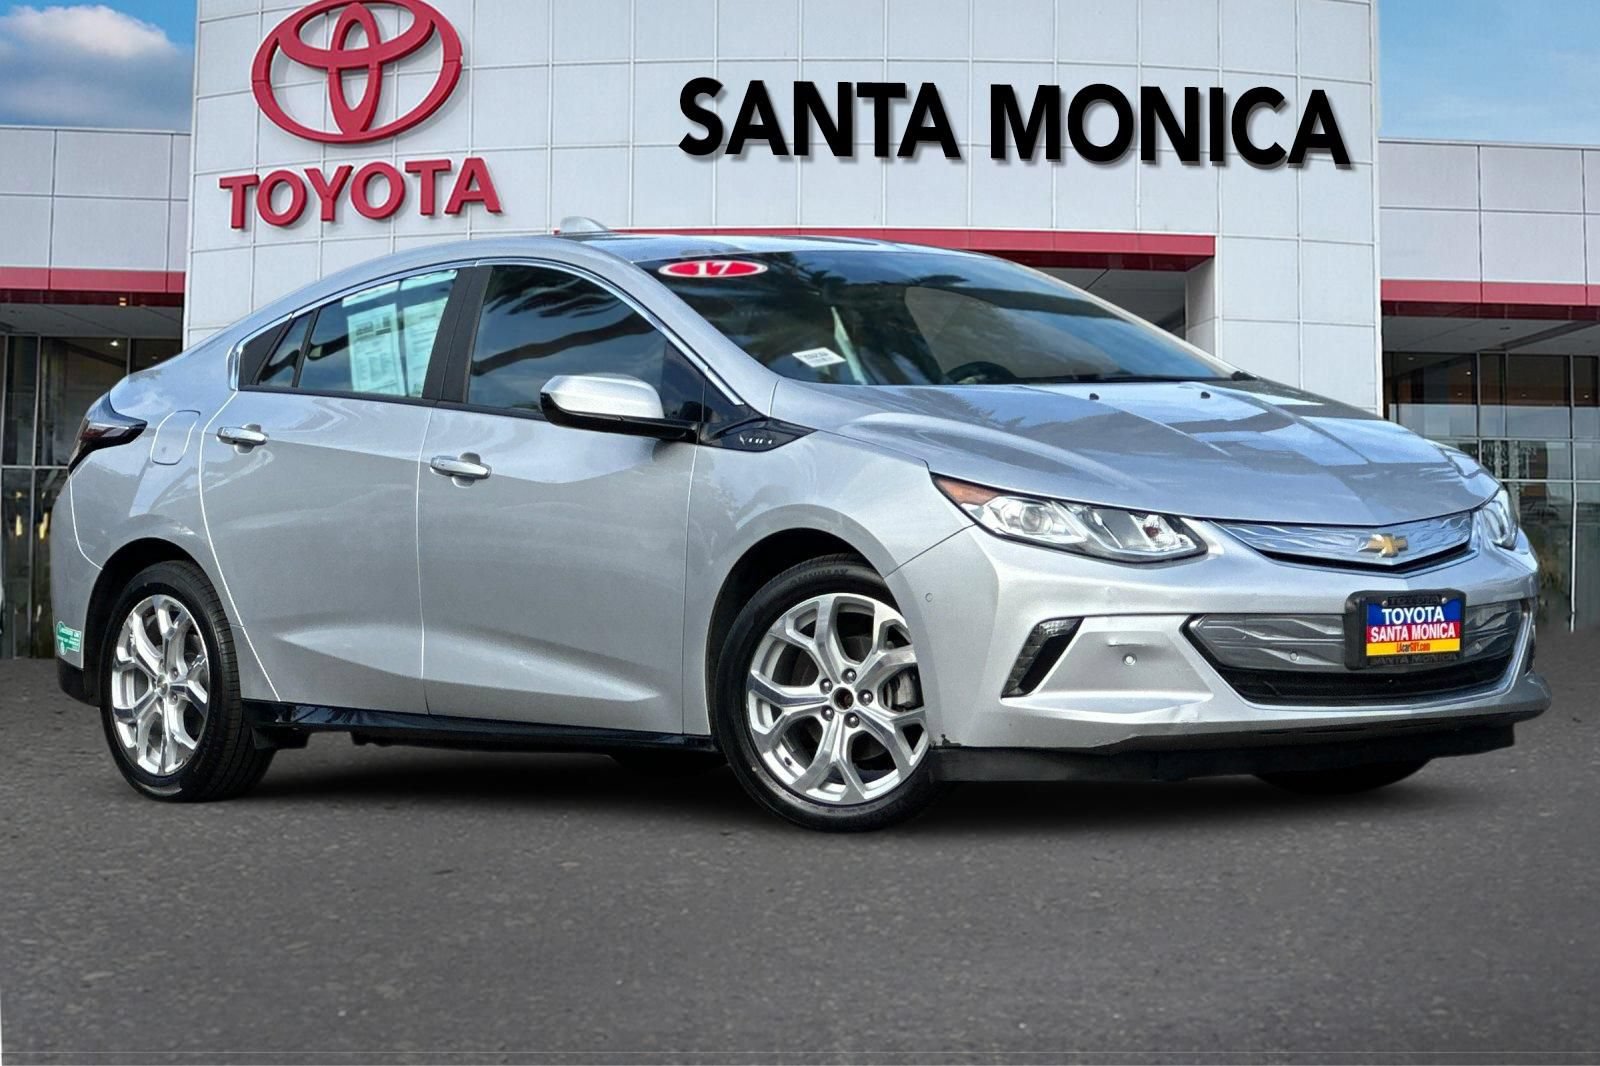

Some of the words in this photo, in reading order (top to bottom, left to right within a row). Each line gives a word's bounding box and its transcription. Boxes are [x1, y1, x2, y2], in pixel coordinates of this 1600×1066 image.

[678, 76, 961, 161] SANTA
[990, 82, 1352, 170] MONICA
[219, 157, 503, 229] TOYOTA
[693, 260, 733, 277] 17
[1382, 606, 1445, 625] TOYOTA
[1371, 625, 1410, 643] SANTA
[1411, 623, 1456, 640] MONICA
